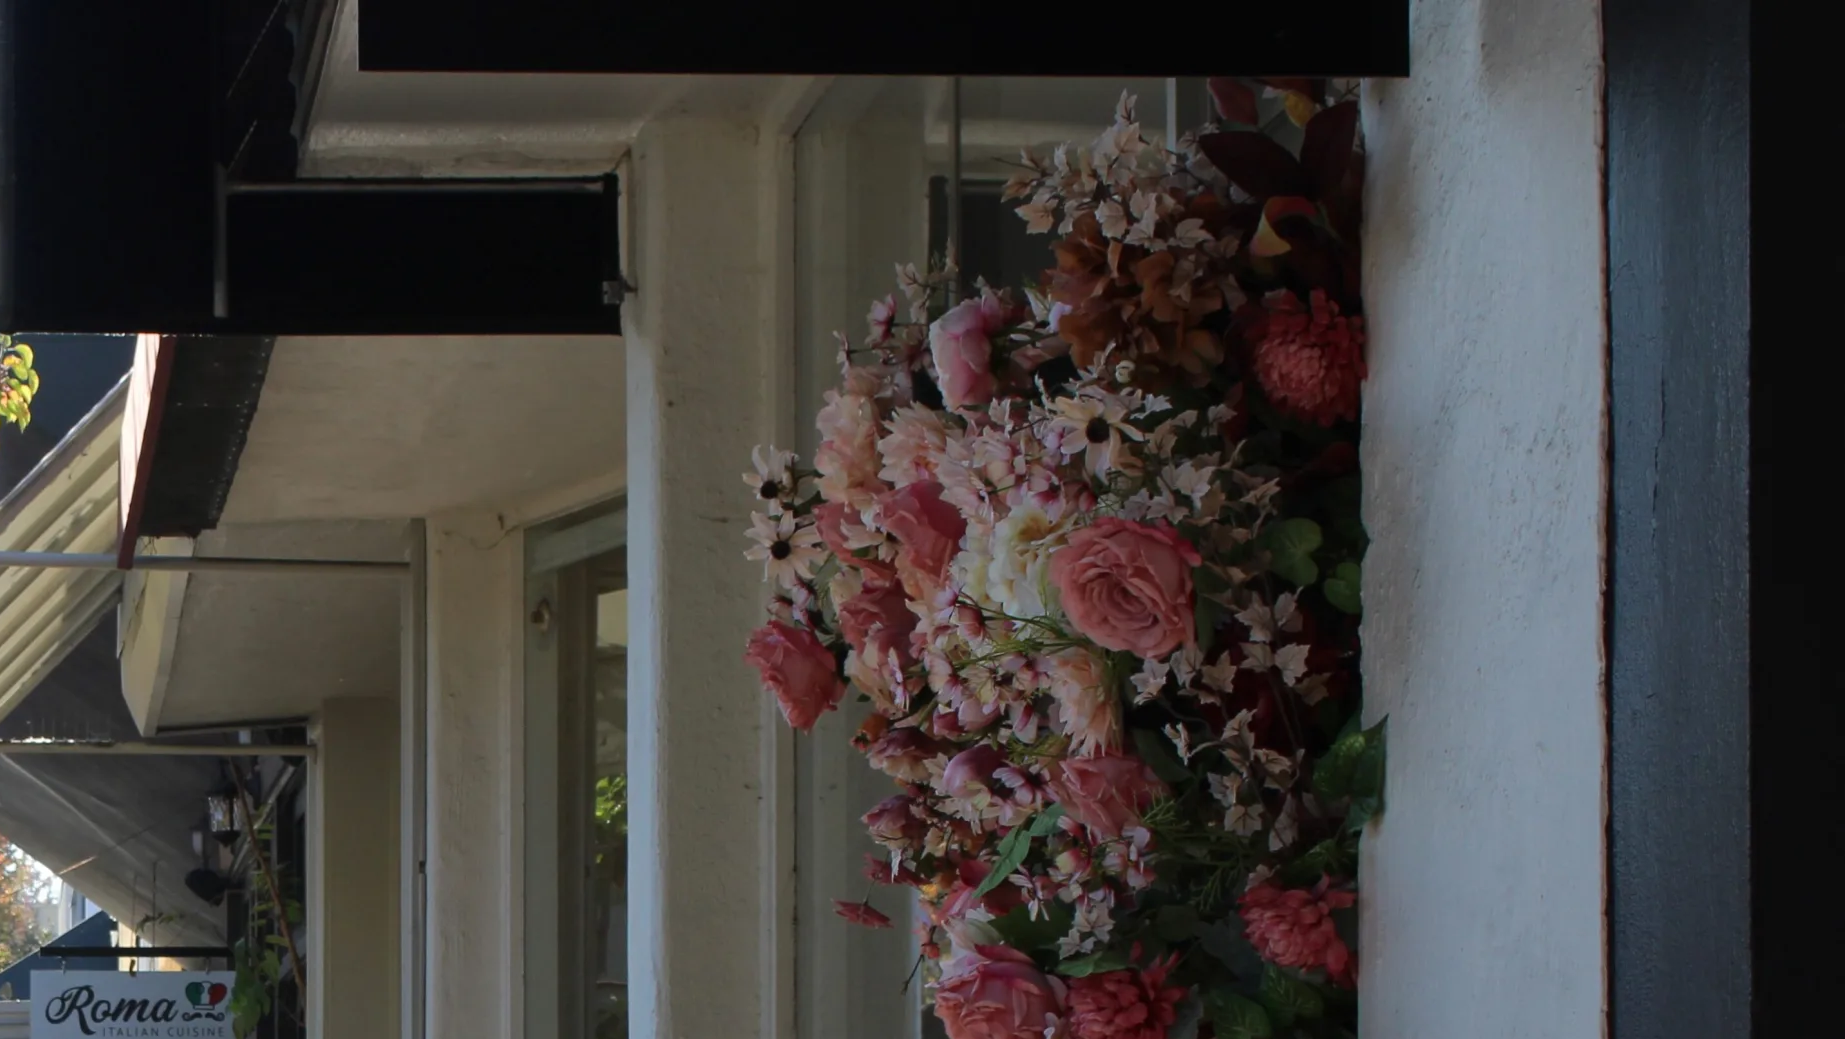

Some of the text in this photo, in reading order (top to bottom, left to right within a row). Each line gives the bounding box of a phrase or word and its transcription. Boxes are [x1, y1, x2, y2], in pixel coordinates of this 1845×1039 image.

[45, 985, 179, 1036] Roma
[102, 1026, 225, 1038] ITALIAN CUISINE
